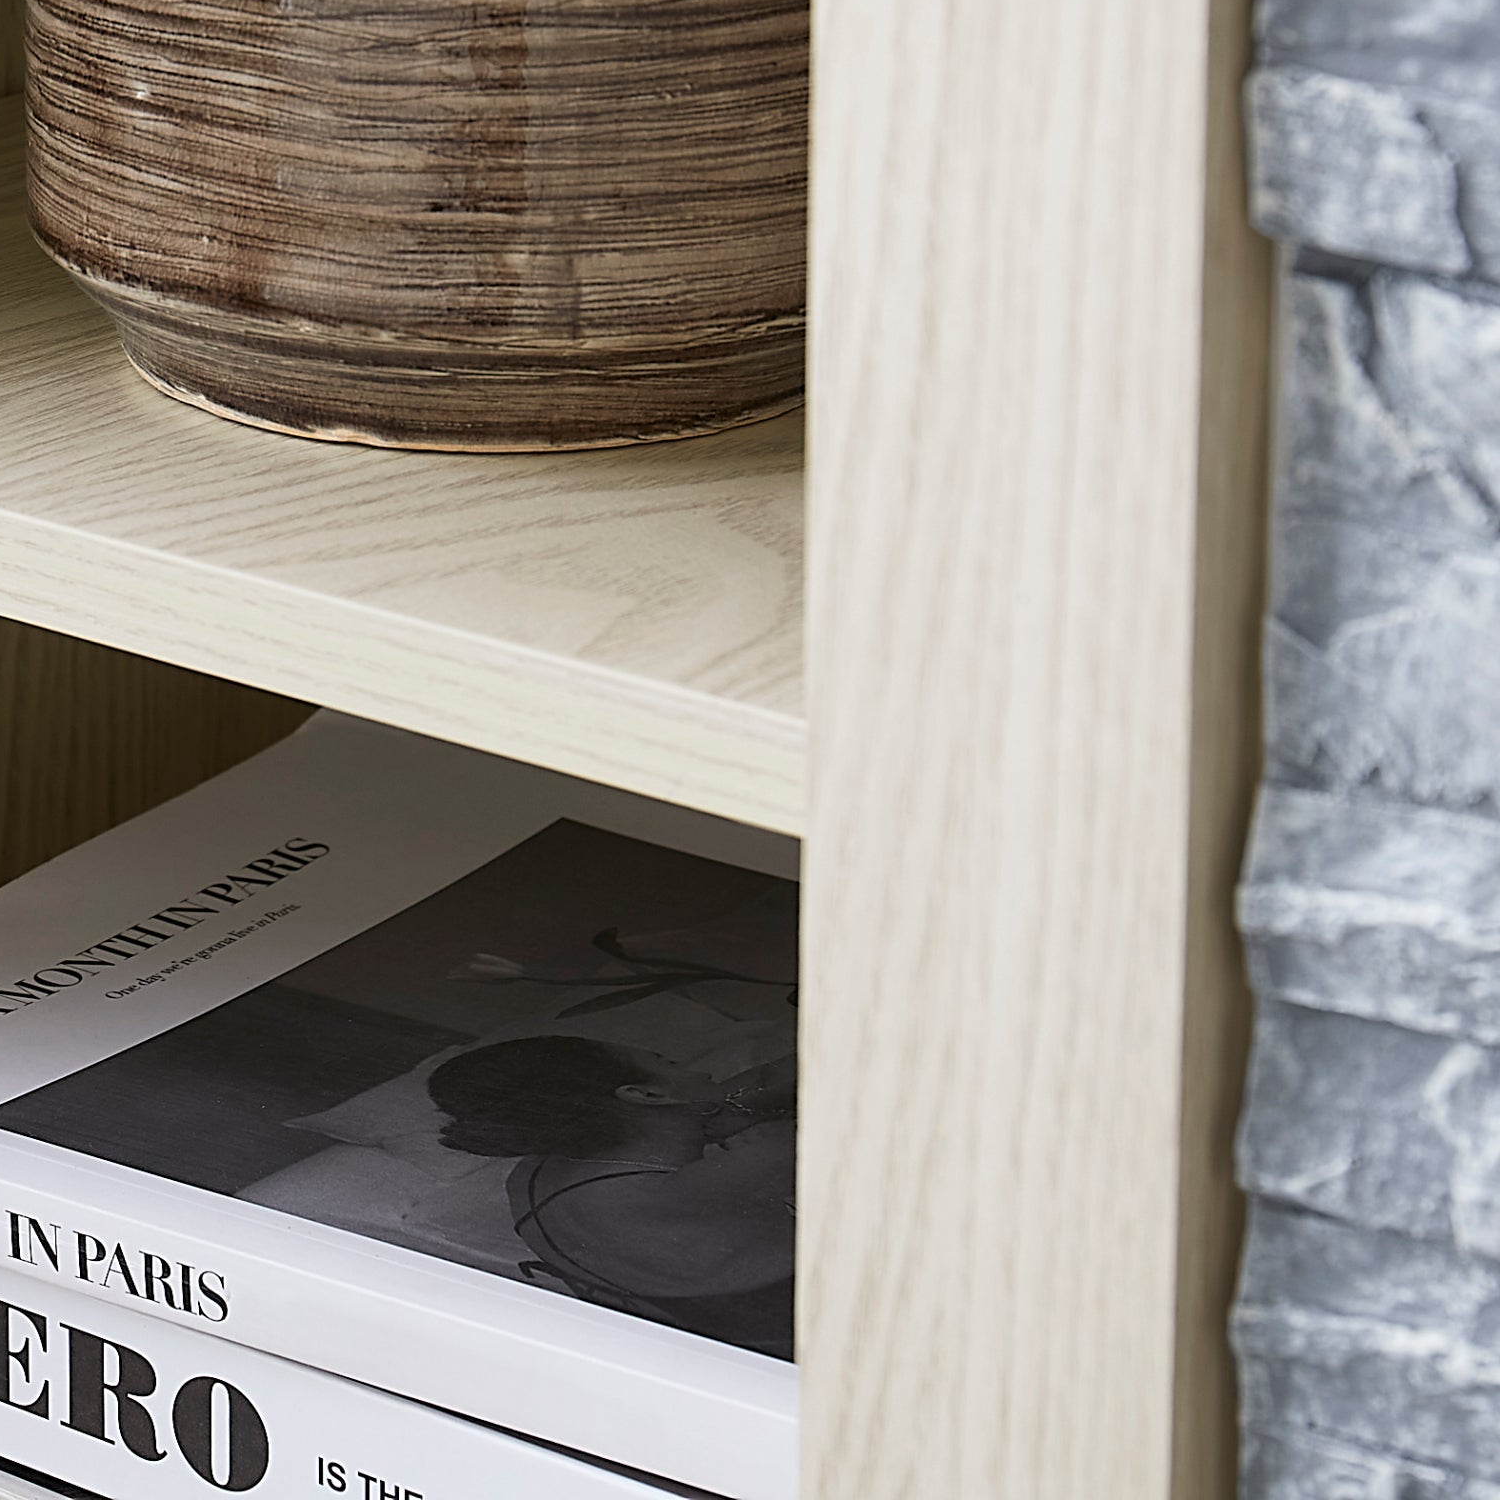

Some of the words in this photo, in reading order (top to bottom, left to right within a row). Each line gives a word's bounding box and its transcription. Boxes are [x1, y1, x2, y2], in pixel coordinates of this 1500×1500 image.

[148, 898, 220, 931] IN
[197, 837, 330, 906] PARIS
[105, 983, 140, 1000] One
[136, 971, 168, 991] day
[195, 935, 236, 960] gonna
[227, 920, 257, 940] live
[250, 910, 271, 928] in
[5, 1208, 63, 1273] IN
[73, 1229, 229, 1322] PARIS
[318, 1456, 347, 1492] IS
